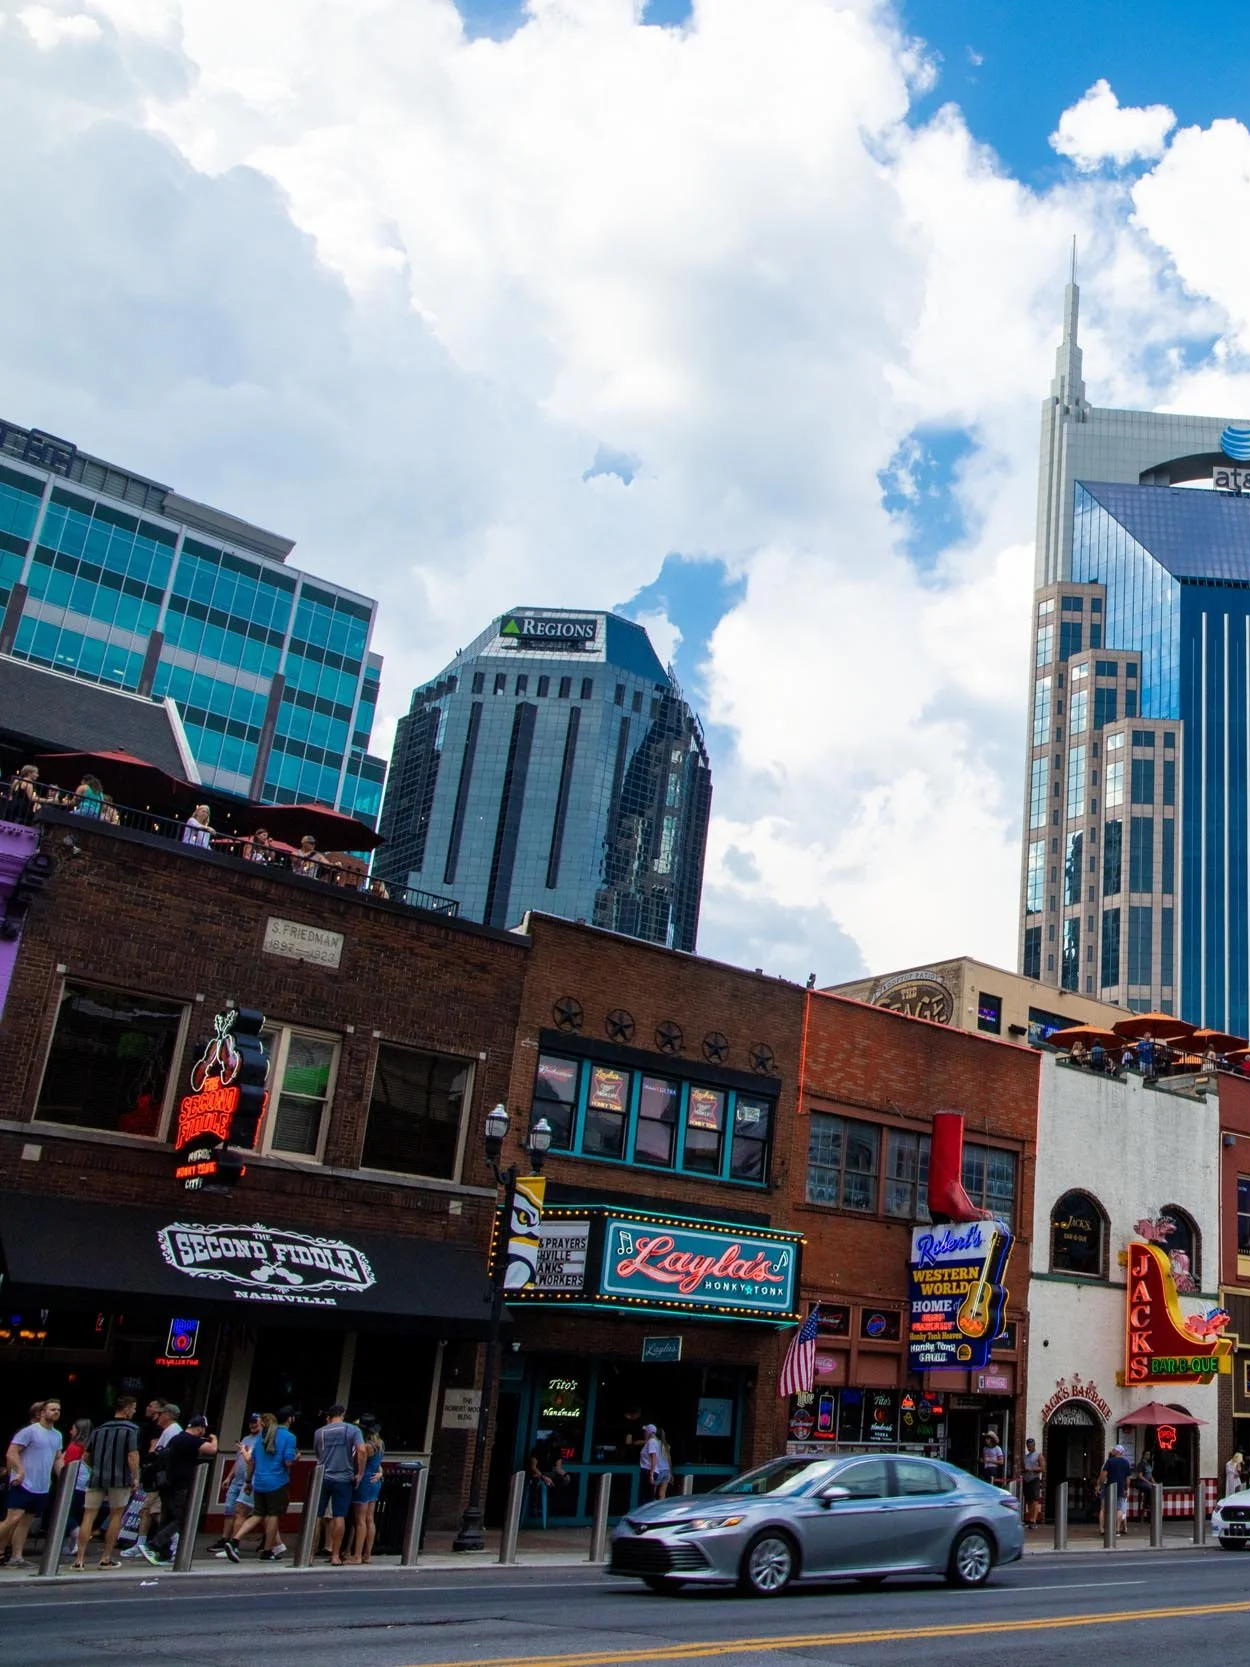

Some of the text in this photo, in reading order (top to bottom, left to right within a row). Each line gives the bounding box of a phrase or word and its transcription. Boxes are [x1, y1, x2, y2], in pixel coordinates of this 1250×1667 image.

[522, 618, 594, 638] REGIONS
[901, 987, 918, 1000] THE
[180, 1087, 239, 1122] SECOND
[175, 1112, 231, 1151] FIDDLE
[184, 1177, 204, 1190] CITY
[253, 1232, 273, 1241] THE
[546, 1238, 586, 1249] PRAYERS
[917, 1224, 983, 1269] Robert's
[175, 1233, 362, 1283] SECOND FIDDLE
[616, 1236, 785, 1294] Layla's
[540, 1274, 584, 1286] WORKERS
[912, 1267, 980, 1283] WESTERN
[705, 1281, 784, 1297] HONKY TONK
[920, 1282, 969, 1296] WORLD
[234, 1290, 338, 1306] NASHVILLE
[912, 1300, 952, 1313] HOME
[1130, 1254, 1153, 1379] JACKS
[941, 1332, 963, 1340] Heaven
[645, 1344, 677, 1358] Layla's
[1152, 1357, 1218, 1373] BAR-B-QUE
[549, 1378, 578, 1391] Tito's
[542, 1407, 581, 1418] Handmade
[1041, 1387, 1070, 1423] JACK'S
[457, 1413, 473, 1421] BLDG
